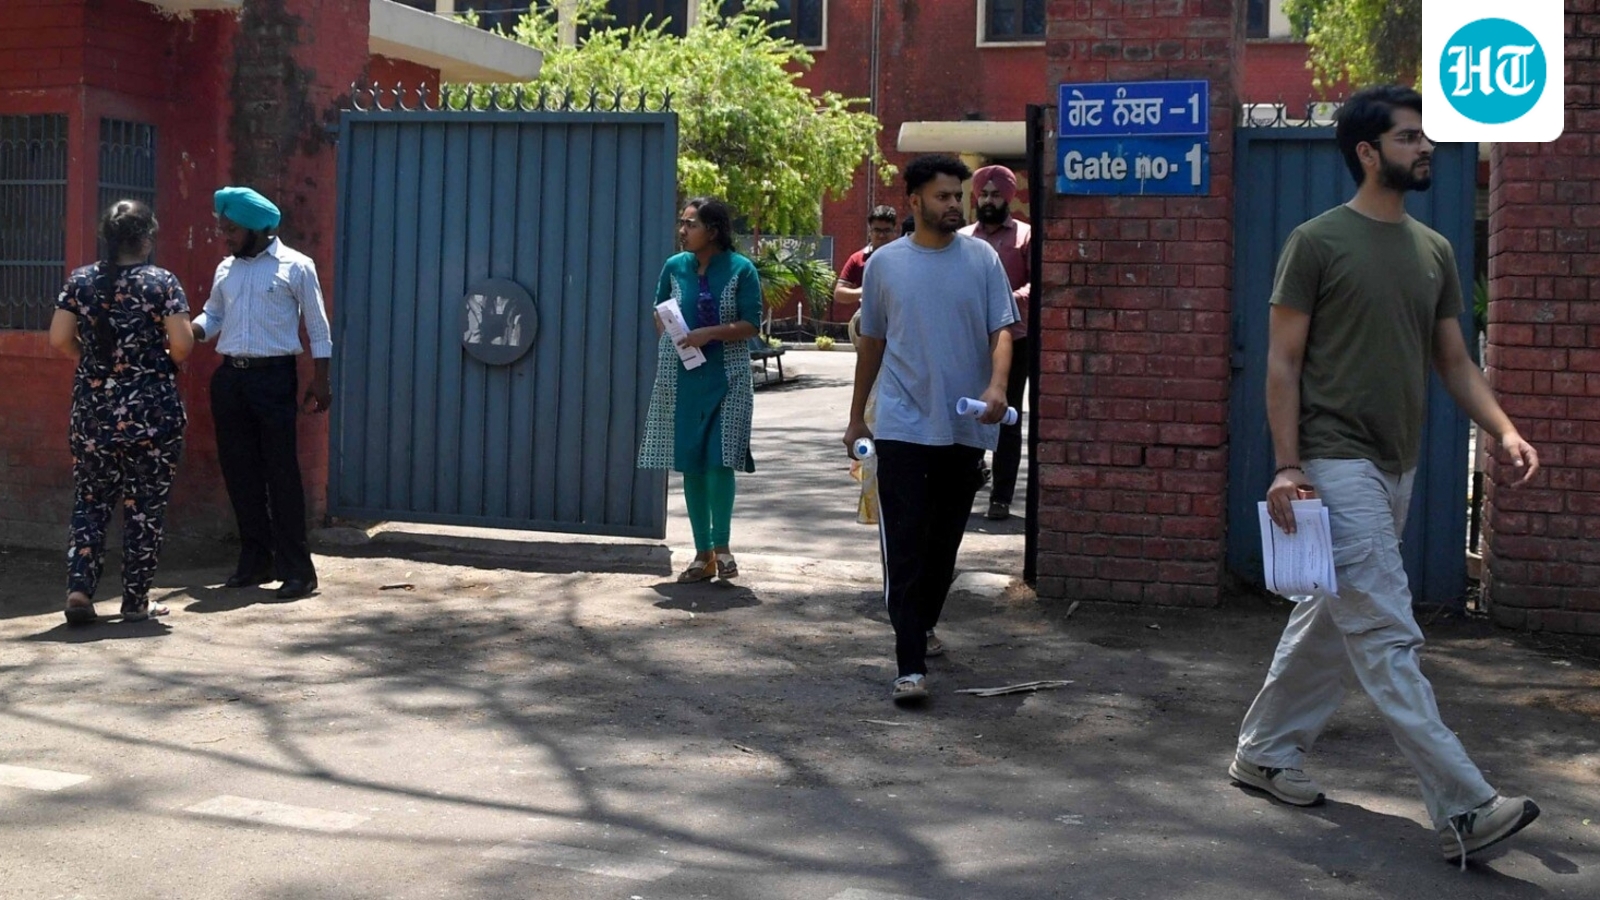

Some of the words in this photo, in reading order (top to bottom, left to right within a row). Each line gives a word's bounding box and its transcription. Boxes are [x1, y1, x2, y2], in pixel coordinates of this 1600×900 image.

[1068, 89, 1105, 126] ਗੇਟ
[1112, 87, 1163, 126] ਨੰਬਰ
[1064, 150, 1127, 180] Gate
